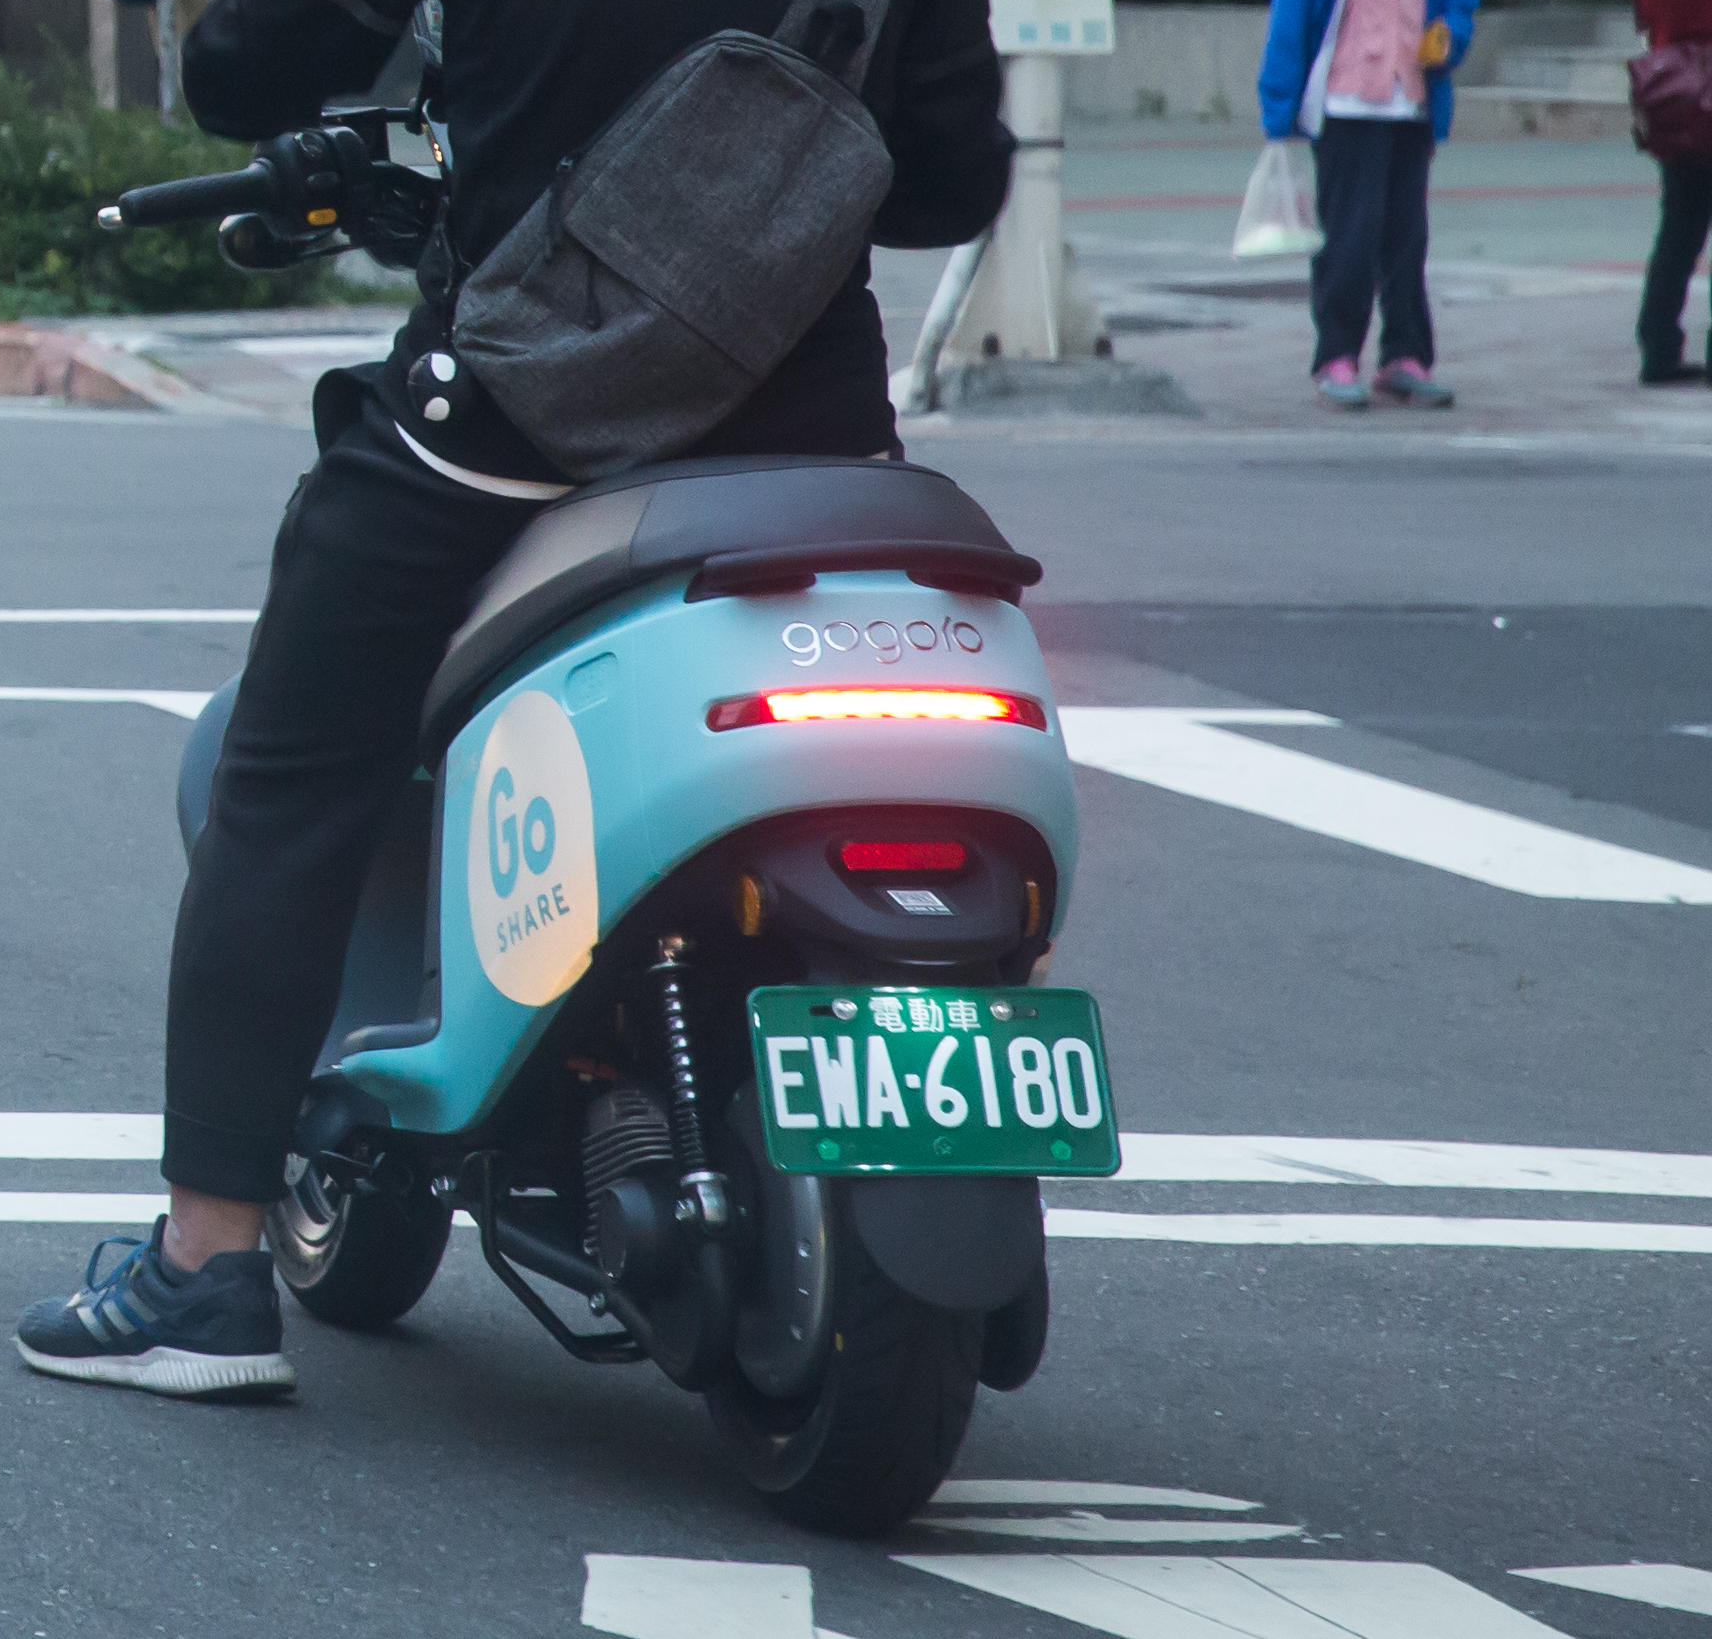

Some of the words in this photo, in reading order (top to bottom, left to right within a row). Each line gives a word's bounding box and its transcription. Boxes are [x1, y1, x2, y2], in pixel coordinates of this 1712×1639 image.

[781, 615, 984, 667] gogoro
[487, 765, 556, 899] Go
[496, 883, 572, 953] SHARE
[869, 997, 982, 1033] 電動車
